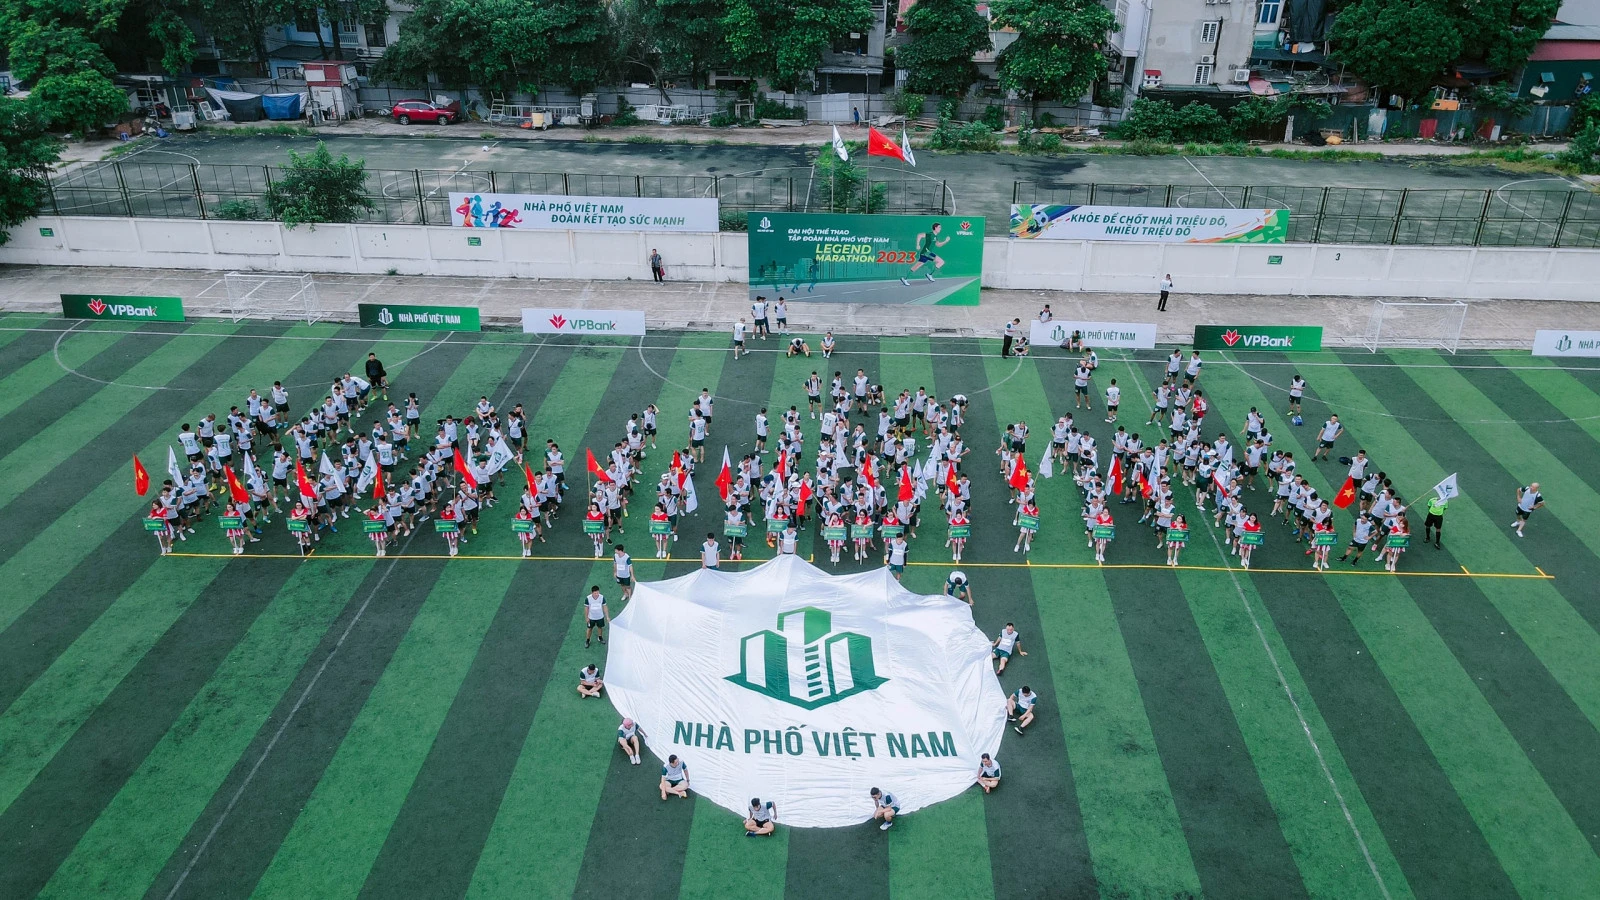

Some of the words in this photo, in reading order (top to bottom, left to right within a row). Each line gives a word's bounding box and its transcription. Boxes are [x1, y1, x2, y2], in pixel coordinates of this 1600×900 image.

[523, 200, 546, 211] NHÀ
[548, 201, 572, 212] PHỐ
[574, 202, 598, 215] VIỆT
[600, 204, 624, 213] NAM
[551, 212, 580, 224] ĐOÀN
[607, 215, 626, 227] TẠO
[629, 214, 651, 225] SỨC
[653, 216, 685, 228] MẠNH
[1070, 211, 1100, 223] KHỎE
[1102, 212, 1119, 223] ĐỂ
[1119, 213, 1148, 225] CHỐT
[1150, 214, 1173, 225] NHÀ
[1176, 215, 1208, 228] TRIỆU
[1105, 224, 1139, 235] NHIỀU
[1142, 225, 1173, 238] TRIỆU
[1175, 225, 1191, 236] ĐÔ
[815, 243, 872, 254] LEGEND
[815, 254, 875, 263] MARATHON
[876, 250, 916, 263] 2023
[1335, 253, 1340, 261] 3
[108, 304, 157, 316] VPBank
[398, 312, 412, 323] NHÀ
[414, 312, 428, 323] PHỐ
[428, 313, 444, 325] VIỆT
[445, 315, 460, 324] NAM
[569, 319, 616, 331] VPBank
[1119, 332, 1136, 341] NAM
[1243, 335, 1292, 347] VPBank
[1579, 339, 1594, 349] NHÀ
[673, 720, 735, 752] NHÀ
[744, 724, 807, 756] PHỐ
[811, 726, 877, 761] VIỆT
[886, 731, 958, 758] NAM
